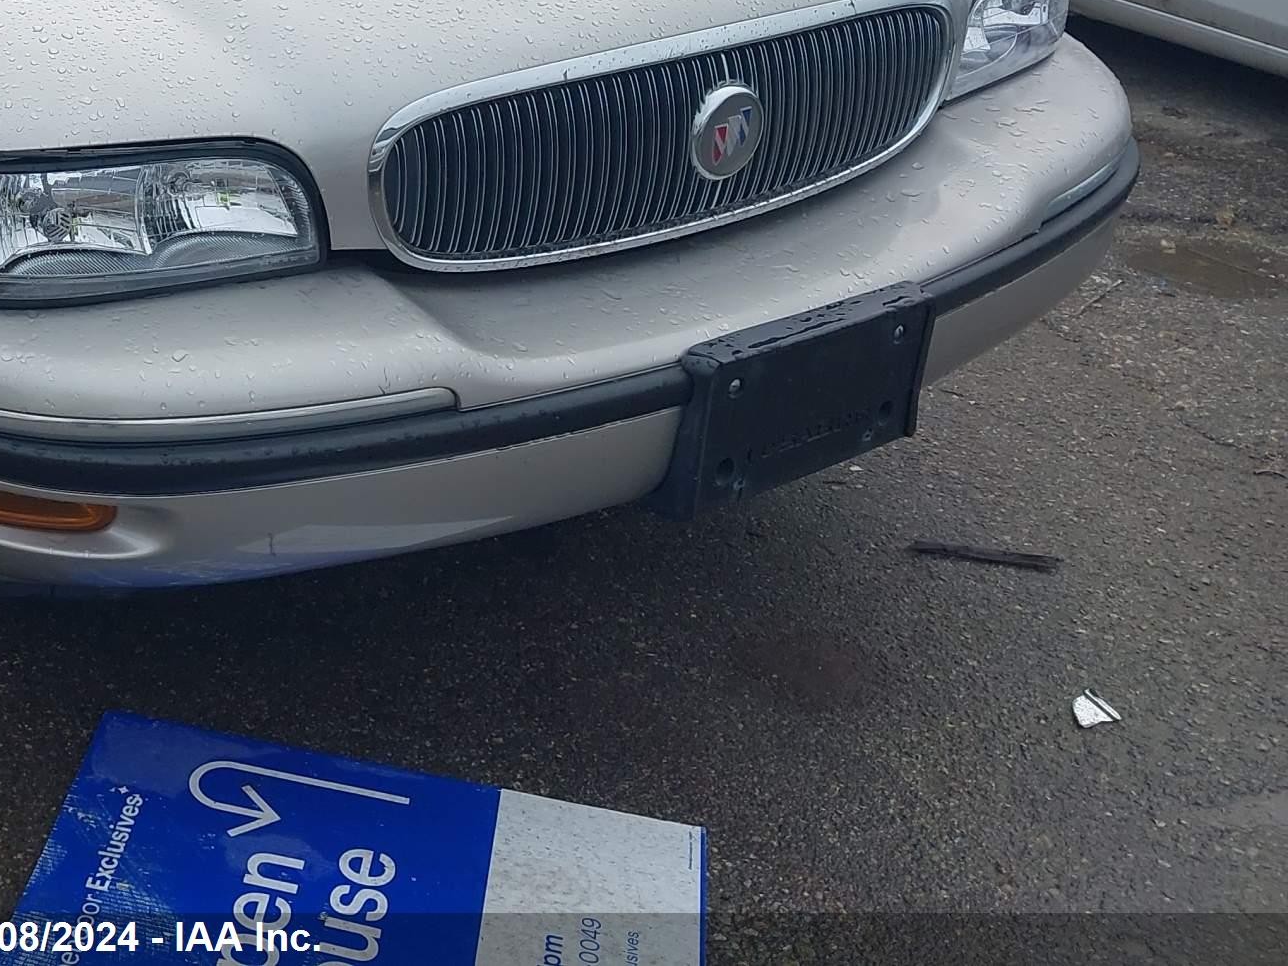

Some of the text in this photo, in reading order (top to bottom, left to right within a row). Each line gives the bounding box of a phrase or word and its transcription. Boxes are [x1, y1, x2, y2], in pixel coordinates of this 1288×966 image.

[85, 793, 143, 892] Exclusives
[318, 848, 396, 966] use
[539, 934, 564, 966] pm
